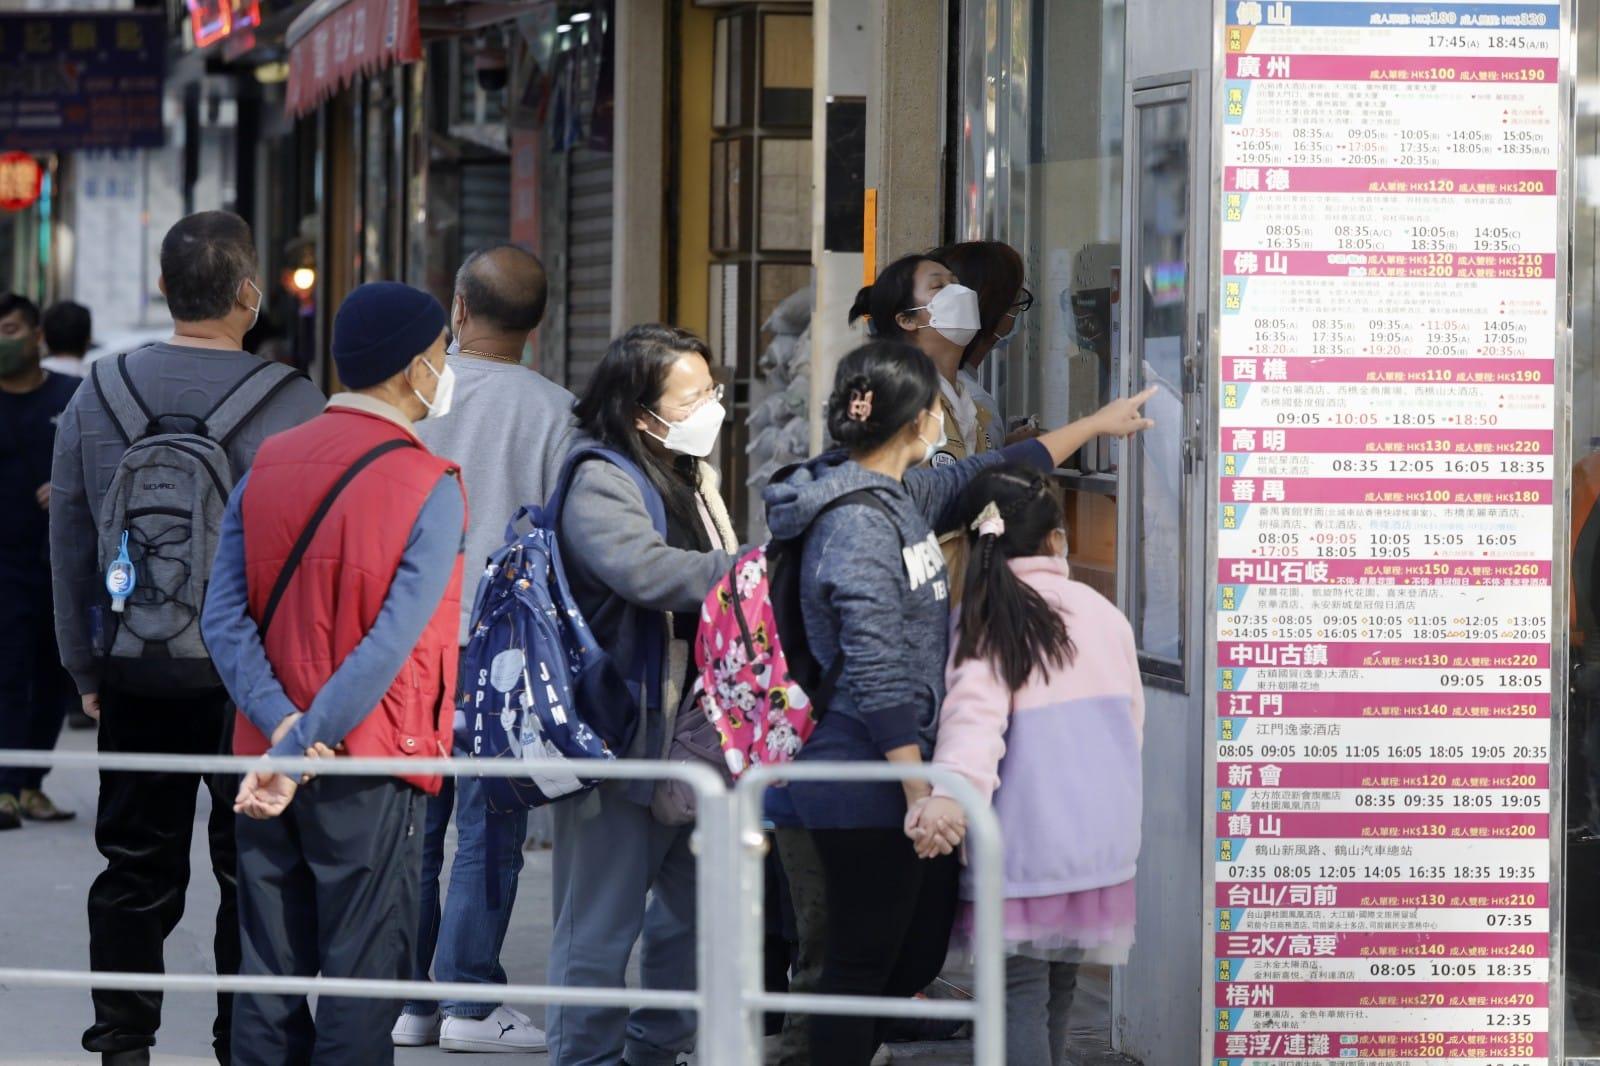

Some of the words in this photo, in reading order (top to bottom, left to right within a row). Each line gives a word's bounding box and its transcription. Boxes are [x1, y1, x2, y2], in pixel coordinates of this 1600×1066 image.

[1236, 2, 1291, 25] 佛山
[1236, 56, 1291, 78] 廣州
[1235, 169, 1290, 190] 順德
[1234, 252, 1288, 274] 佛山
[1233, 358, 1287, 381] 西樵
[1276, 414, 1320, 424] 09:05
[1335, 414, 1378, 424] 10:05
[1393, 414, 1435, 425] 18:05
[1455, 415, 1498, 425] 18:50
[1232, 430, 1285, 451] 高明
[1332, 460, 1378, 472] 08:35
[1389, 460, 1434, 472] 12:05
[1445, 461, 1489, 472] 16:05
[1500, 461, 1545, 473] 18:35
[1231, 480, 1284, 501] 番禺
[1259, 533, 1299, 544] 08:05
[1316, 533, 1356, 544] 09:05
[1370, 534, 1410, 544] 10:05
[1424, 534, 1464, 544] 15:05
[1477, 534, 1516, 545] 16:05
[1259, 547, 1299, 557] 17:05
[1317, 547, 1356, 557] 18:05
[1370, 547, 1410, 557] 19:05
[1231, 561, 1329, 582] 中山石岐
[1405, 564, 1449, 575] HK$150
[1495, 565, 1538, 575] HK$260
[1234, 615, 1267, 625] 07:35
[1279, 615, 1312, 625] 08:05
[1323, 615, 1357, 625] 09:05
[1369, 616, 1402, 625] 10:05
[1414, 616, 1447, 626] 11:05
[1465, 616, 1498, 626] 12:05
[1513, 616, 1546, 626] 13:05
[1234, 628, 1267, 638] 14:05
[1279, 628, 1312, 638] 15:05
[1323, 628, 1357, 638] 16:05
[1369, 629, 1402, 638] 17:05
[1414, 629, 1447, 638] 18:05
[1465, 629, 1498, 639] 19:05
[1513, 629, 1546, 639] 20:05
[1230, 644, 1328, 665] 中山古鎮
[1404, 655, 1448, 665] HK$130
[1494, 655, 1537, 665] HK$220
[1440, 675, 1484, 686] 09:05
[1499, 675, 1542, 687] 18:05
[539, 661, 569, 726] JAM
[1229, 694, 1283, 715] 江門
[1404, 705, 1448, 715] HK$140
[1493, 705, 1537, 716] HK$250
[473, 669, 488, 772] SPAC
[1256, 723, 1340, 736] 江門逸豪酒店
[1219, 746, 1253, 757] 08:05
[1261, 746, 1295, 757] 09:05
[1304, 746, 1338, 757] 10:05
[1346, 746, 1379, 758] 11:05
[1387, 747, 1421, 758] 16:05
[1430, 747, 1463, 758] 18:05
[1472, 747, 1505, 758] 19:05
[1513, 747, 1546, 758] 20:35
[1228, 765, 1282, 786] 新會
[1403, 775, 1447, 786] HK$120
[1492, 776, 1536, 786] HK$200
[1355, 795, 1395, 806] 08:35
[1404, 795, 1444, 807] 09:35
[1453, 795, 1492, 807] 18:05
[1502, 796, 1541, 807] 19:05
[1228, 815, 1281, 836] 鶴山
[1402, 825, 1446, 836] HK$130
[1492, 825, 1535, 836] HK$200
[1229, 866, 1266, 878] 07:35
[1274, 866, 1311, 878] 08:05
[1320, 866, 1356, 878] 12:05
[1364, 866, 1401, 878] 14:05
[1409, 867, 1445, 878] 16:35
[1454, 867, 1490, 878] 18:35
[1499, 867, 1535, 878] 19:35
[1228, 884, 1337, 906] 台山/司前
[1402, 894, 1446, 905] HK$130
[1491, 895, 1535, 906] HK$210
[1487, 914, 1532, 926] 07:35
[1227, 935, 1337, 957] 三水/高要
[1401, 945, 1445, 955] HK$140
[1490, 945, 1535, 956] HK$240
[1370, 964, 1415, 976] 08:05
[1431, 964, 1476, 976] 10:05
[1487, 964, 1532, 976] 18:35
[1226, 984, 1273, 1005] 梧州
[1401, 994, 1445, 1005] HK$270
[1490, 994, 1534, 1005] HK$470
[1487, 1014, 1531, 1026] 12:35
[1226, 1034, 1330, 1056] 雲浮/連灘
